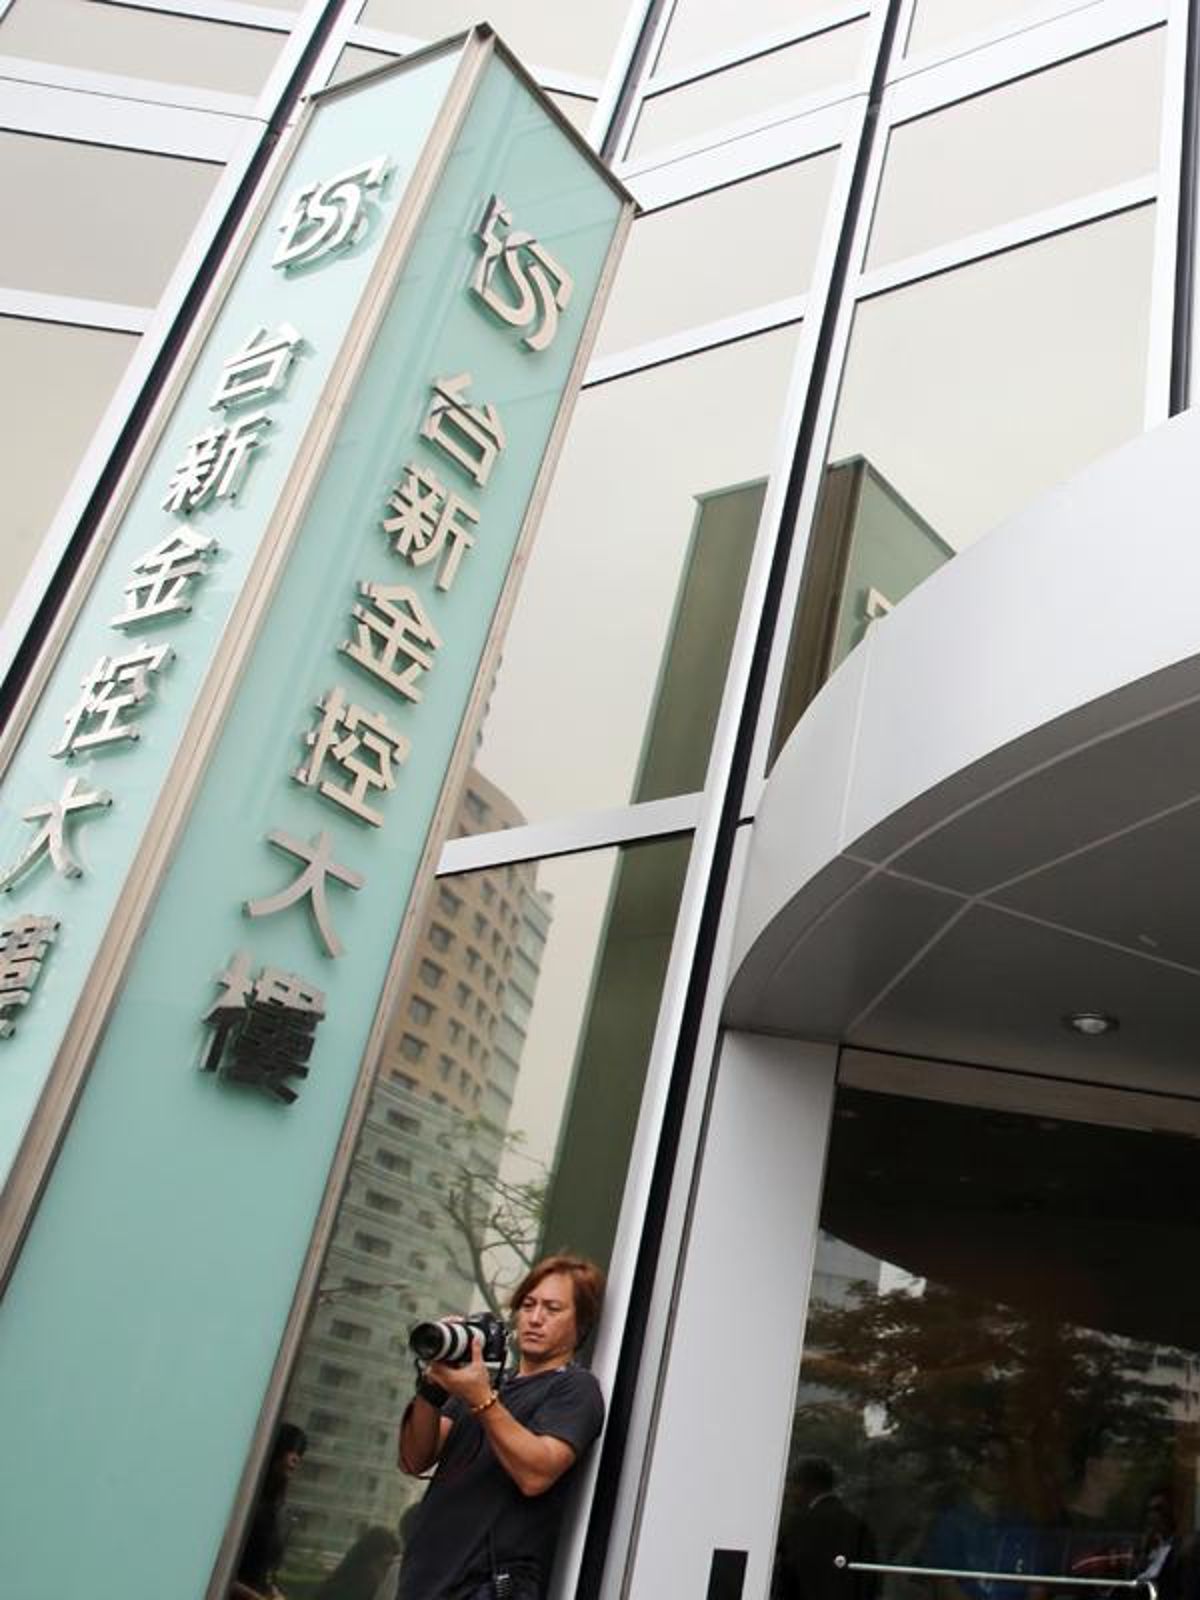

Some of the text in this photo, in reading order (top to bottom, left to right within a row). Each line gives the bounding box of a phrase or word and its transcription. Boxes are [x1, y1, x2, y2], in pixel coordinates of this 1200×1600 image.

[199, 373, 504, 1105] 台新金控大樓
